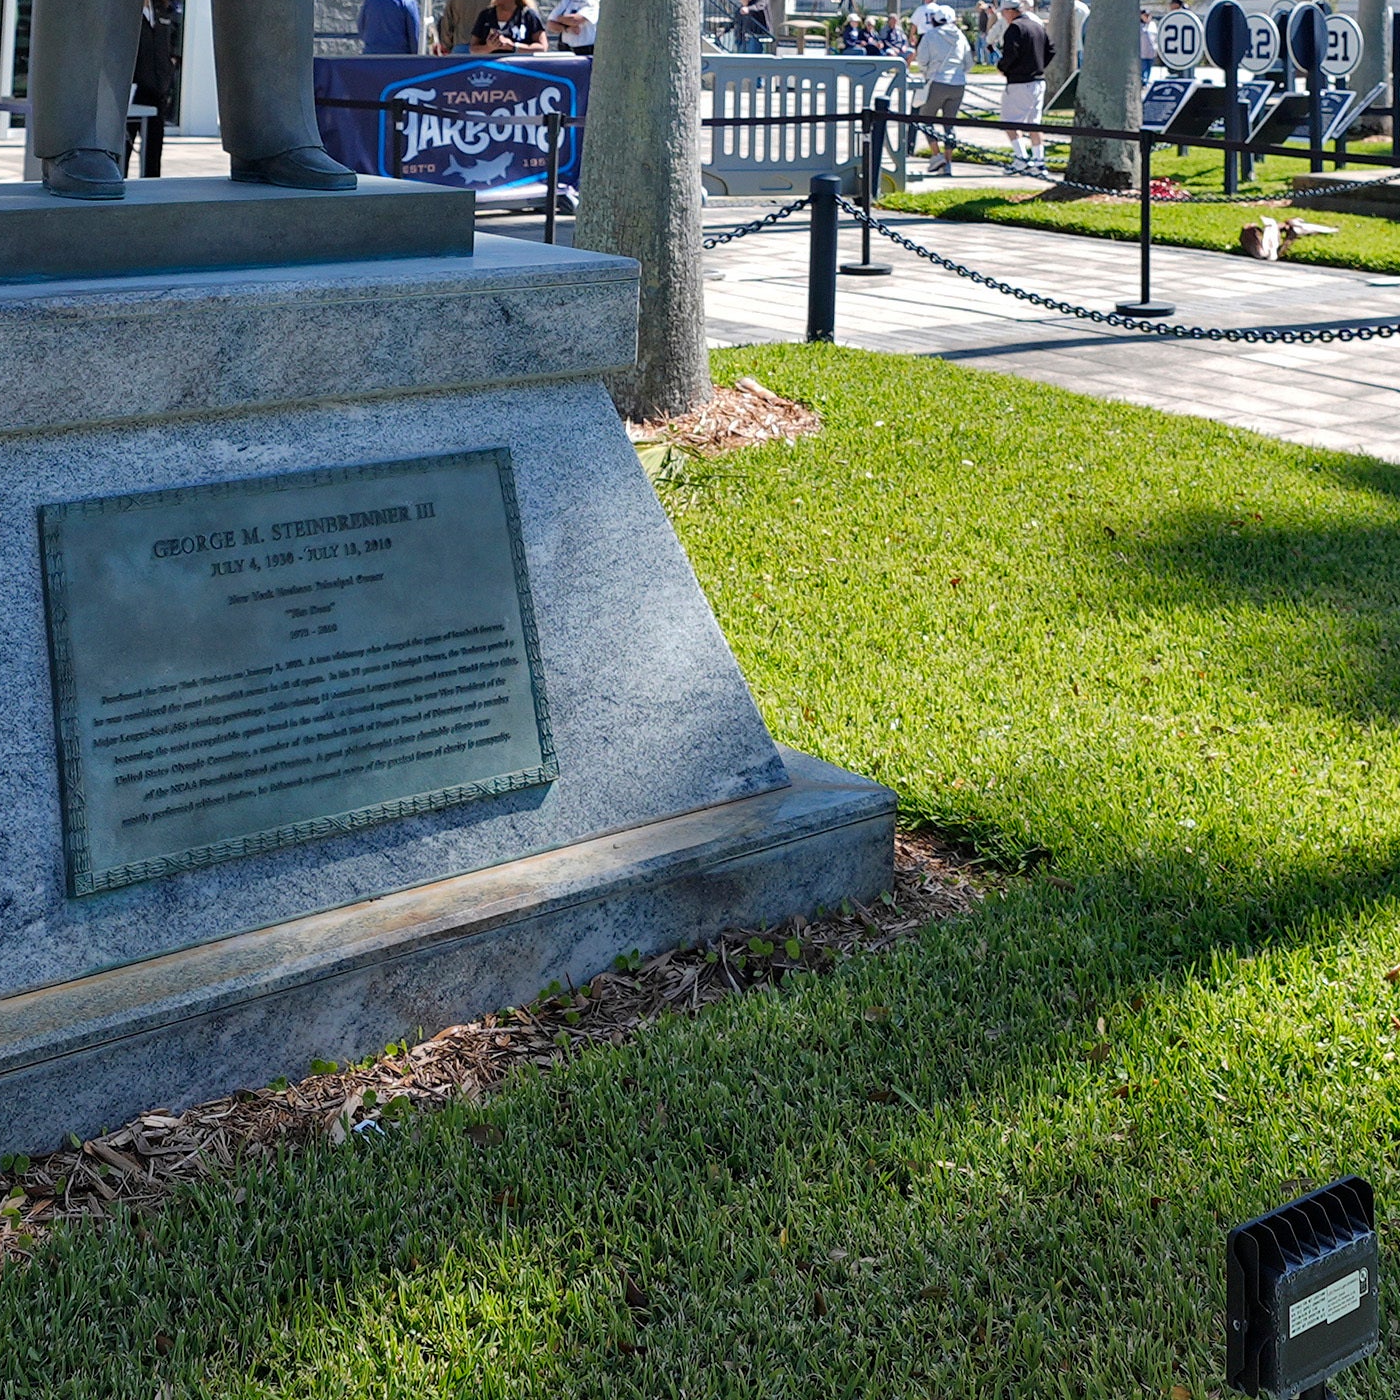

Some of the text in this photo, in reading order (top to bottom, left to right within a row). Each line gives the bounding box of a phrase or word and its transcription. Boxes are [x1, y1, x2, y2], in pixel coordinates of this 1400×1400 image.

[1164, 24, 1196, 55] 20
[1327, 31, 1350, 61] 21
[443, 89, 518, 105] TAMPA
[394, 86, 566, 163] TARPONS
[522, 157, 547, 168] 195
[152, 501, 436, 559] GEORGE M. STEINBRENNER III
[208, 557, 246, 577] JULY
[247, 555, 262, 573] 4,
[264, 550, 295, 569] 1930
[305, 543, 340, 562] JULY
[363, 535, 393, 553] 2010
